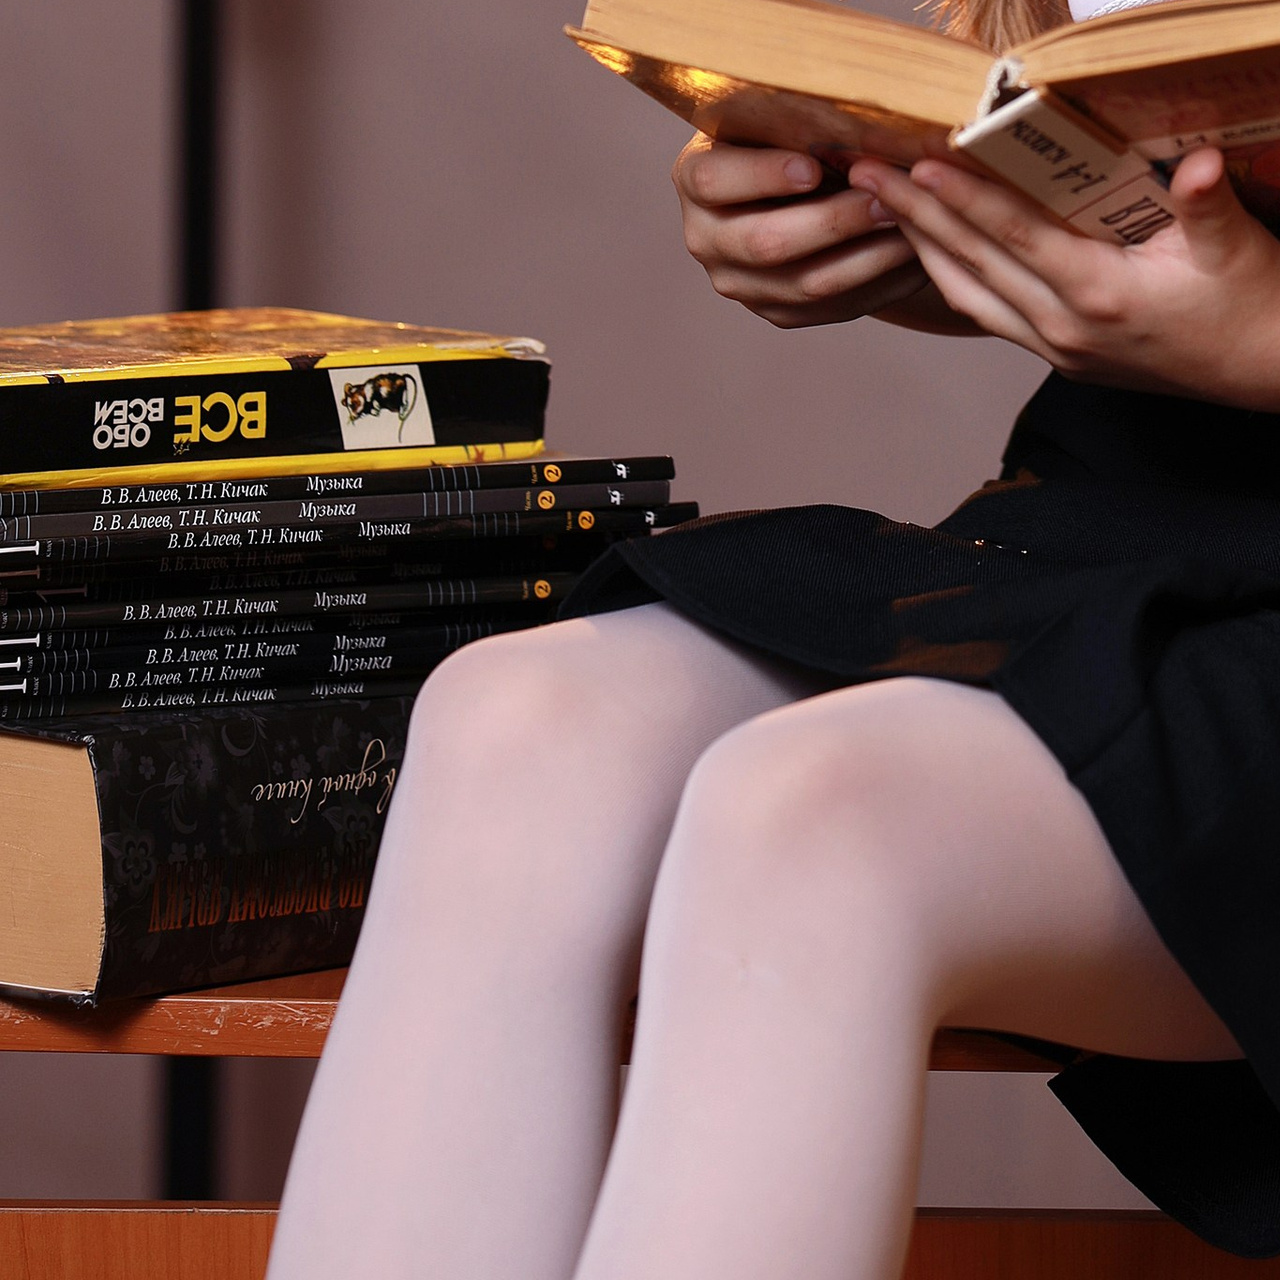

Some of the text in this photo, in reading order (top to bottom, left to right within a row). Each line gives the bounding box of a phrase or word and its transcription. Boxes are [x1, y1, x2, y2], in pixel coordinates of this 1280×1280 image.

[94, 397, 165, 426] ВСЕМ
[174, 391, 267, 444] ВСЕ
[93, 423, 151, 450] ОБО
[305, 476, 363, 495] Музыка
[298, 502, 357, 522] Музыка
[358, 521, 411, 540] Музыка
[313, 591, 367, 611] Музыка
[333, 635, 386, 653] Музыка
[329, 654, 392, 676] Музыка
[311, 681, 365, 699] Музыка
[318, 738, 386, 811] одной
[251, 778, 313, 823] книге
